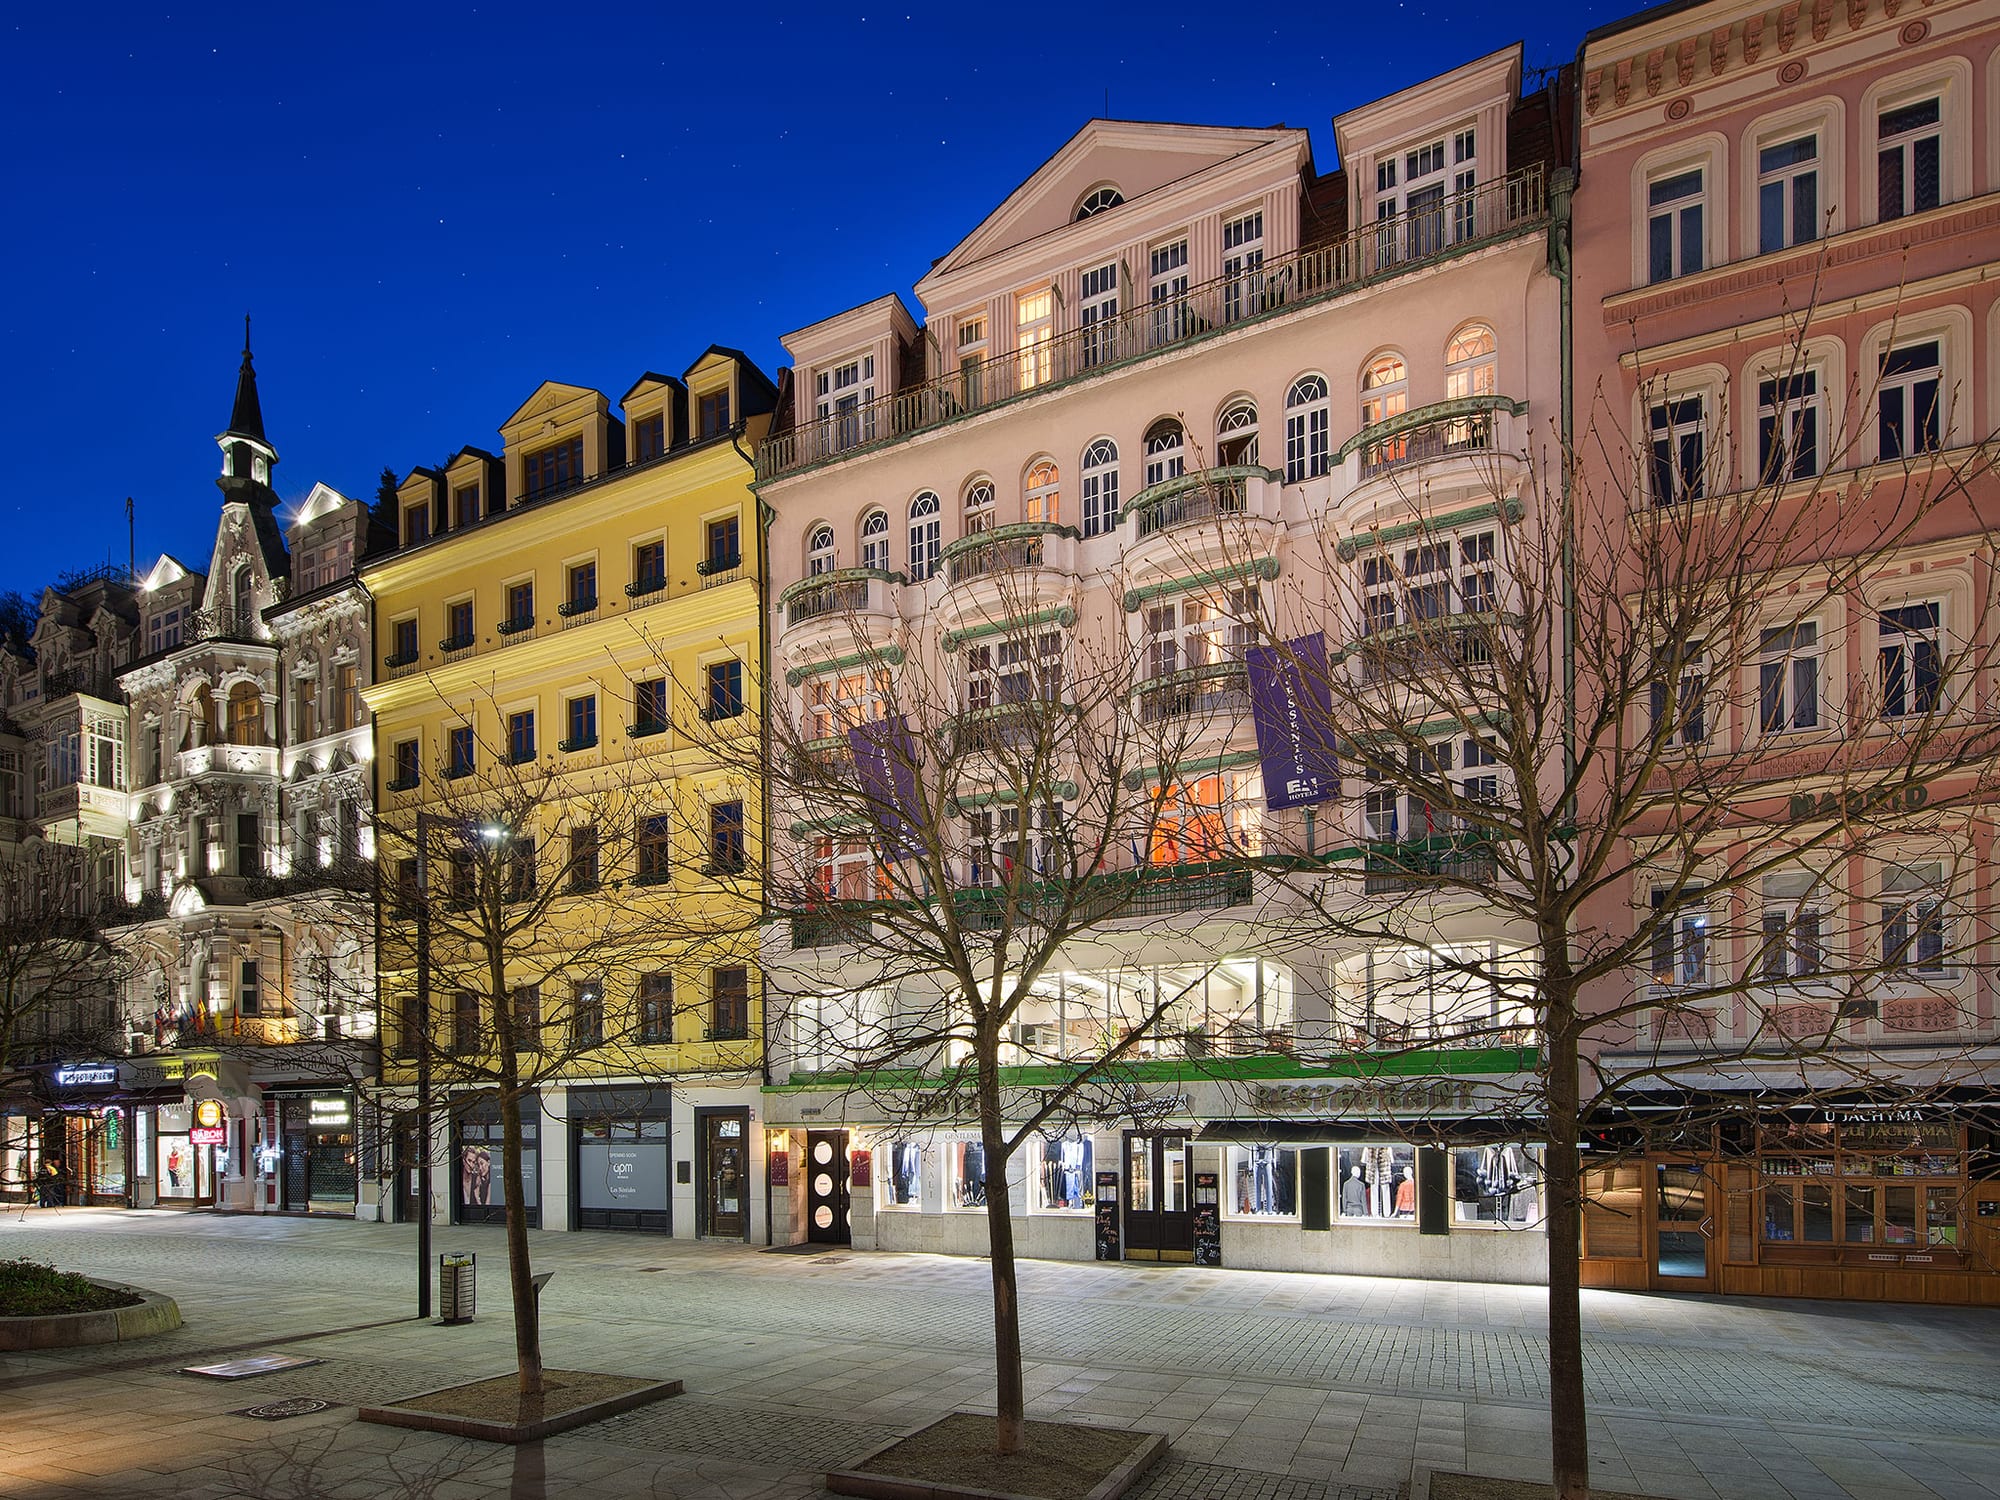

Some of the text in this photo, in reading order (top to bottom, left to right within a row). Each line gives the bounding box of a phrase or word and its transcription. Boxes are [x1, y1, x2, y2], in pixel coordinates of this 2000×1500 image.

[1289, 790, 1319, 801] HOTELS
[136, 1065, 185, 1080] RESTAURAN
[1255, 1082, 1477, 1112] RESTAURANT
[1824, 1111, 1836, 1122] U
[945, 1132, 982, 1140] GENTLEMA
